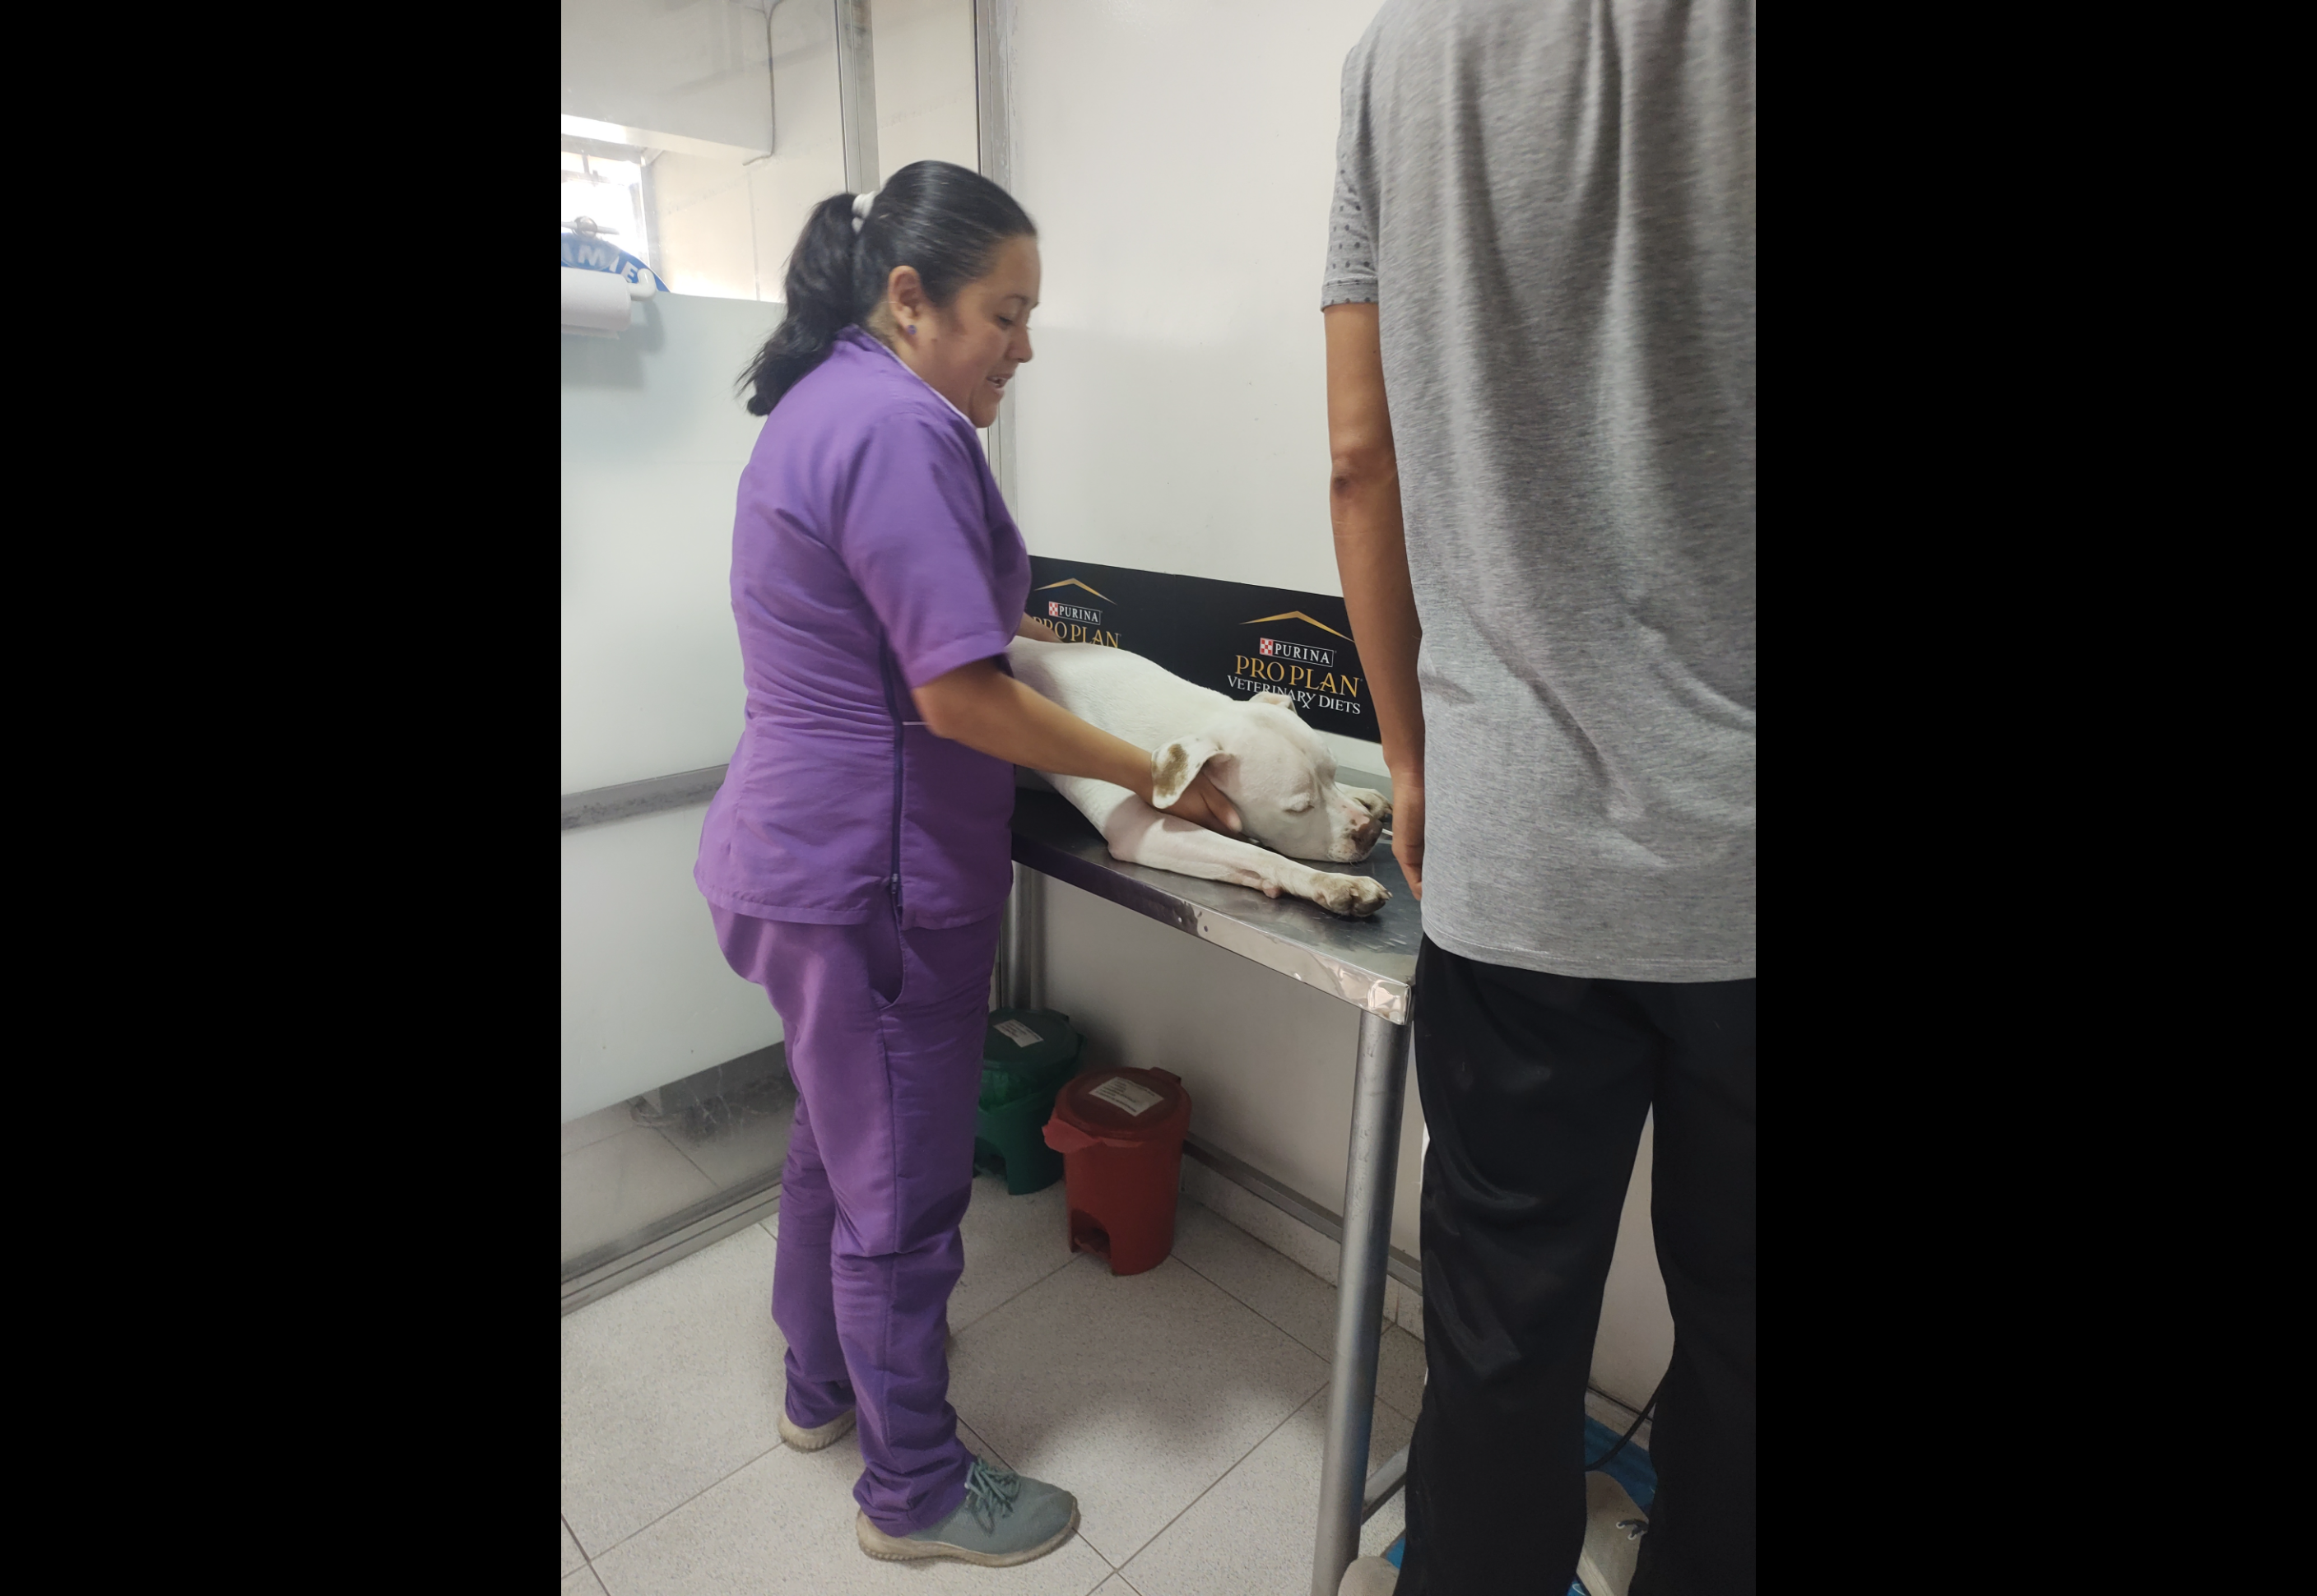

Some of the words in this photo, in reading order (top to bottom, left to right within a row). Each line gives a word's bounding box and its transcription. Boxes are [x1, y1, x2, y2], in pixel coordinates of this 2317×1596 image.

[1059, 605, 1098, 623] PURINA
[1275, 643, 1330, 665] PURINA
[1235, 654, 1285, 682] PRO
[1289, 665, 1360, 698] PLAN
[1318, 694, 1361, 715] DIETS
